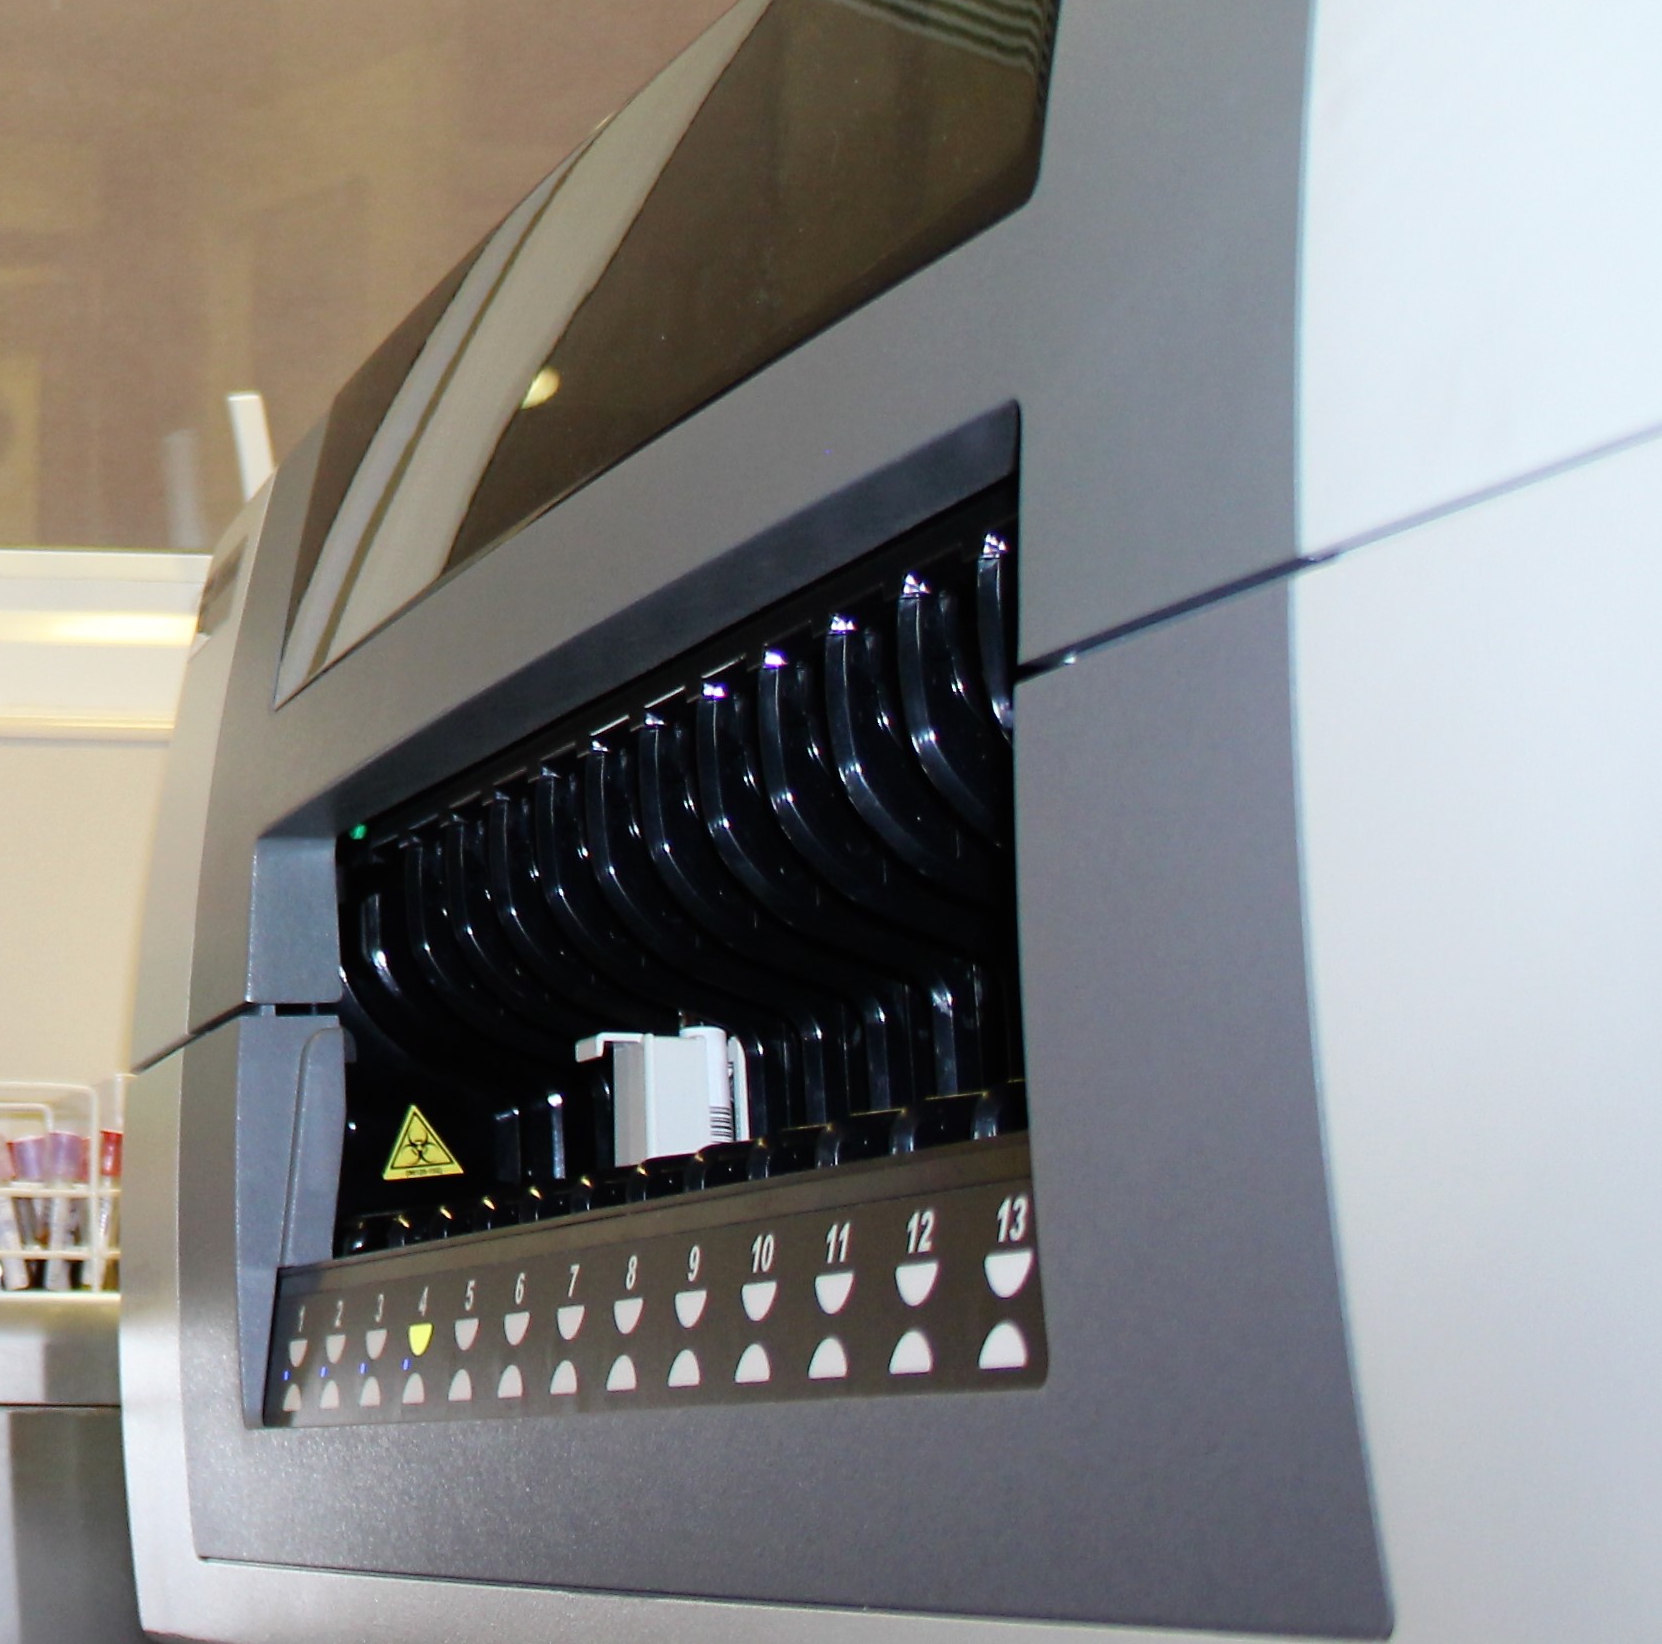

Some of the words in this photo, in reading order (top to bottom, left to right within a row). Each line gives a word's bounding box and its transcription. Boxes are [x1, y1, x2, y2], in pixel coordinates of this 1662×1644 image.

[298, 1306, 306, 1332] 1
[334, 1300, 344, 1327] 2
[375, 1293, 385, 1322] 3
[418, 1286, 429, 1316] 4
[464, 1280, 476, 1311] 5
[514, 1272, 526, 1305] 6
[568, 1263, 580, 1297] 7
[625, 1254, 638, 1291] 8
[688, 1245, 701, 1282] 9
[751, 1233, 775, 1273] 10
[826, 1222, 851, 1264] 11
[907, 1208, 936, 1254] 12
[997, 1194, 1029, 1243] 13
